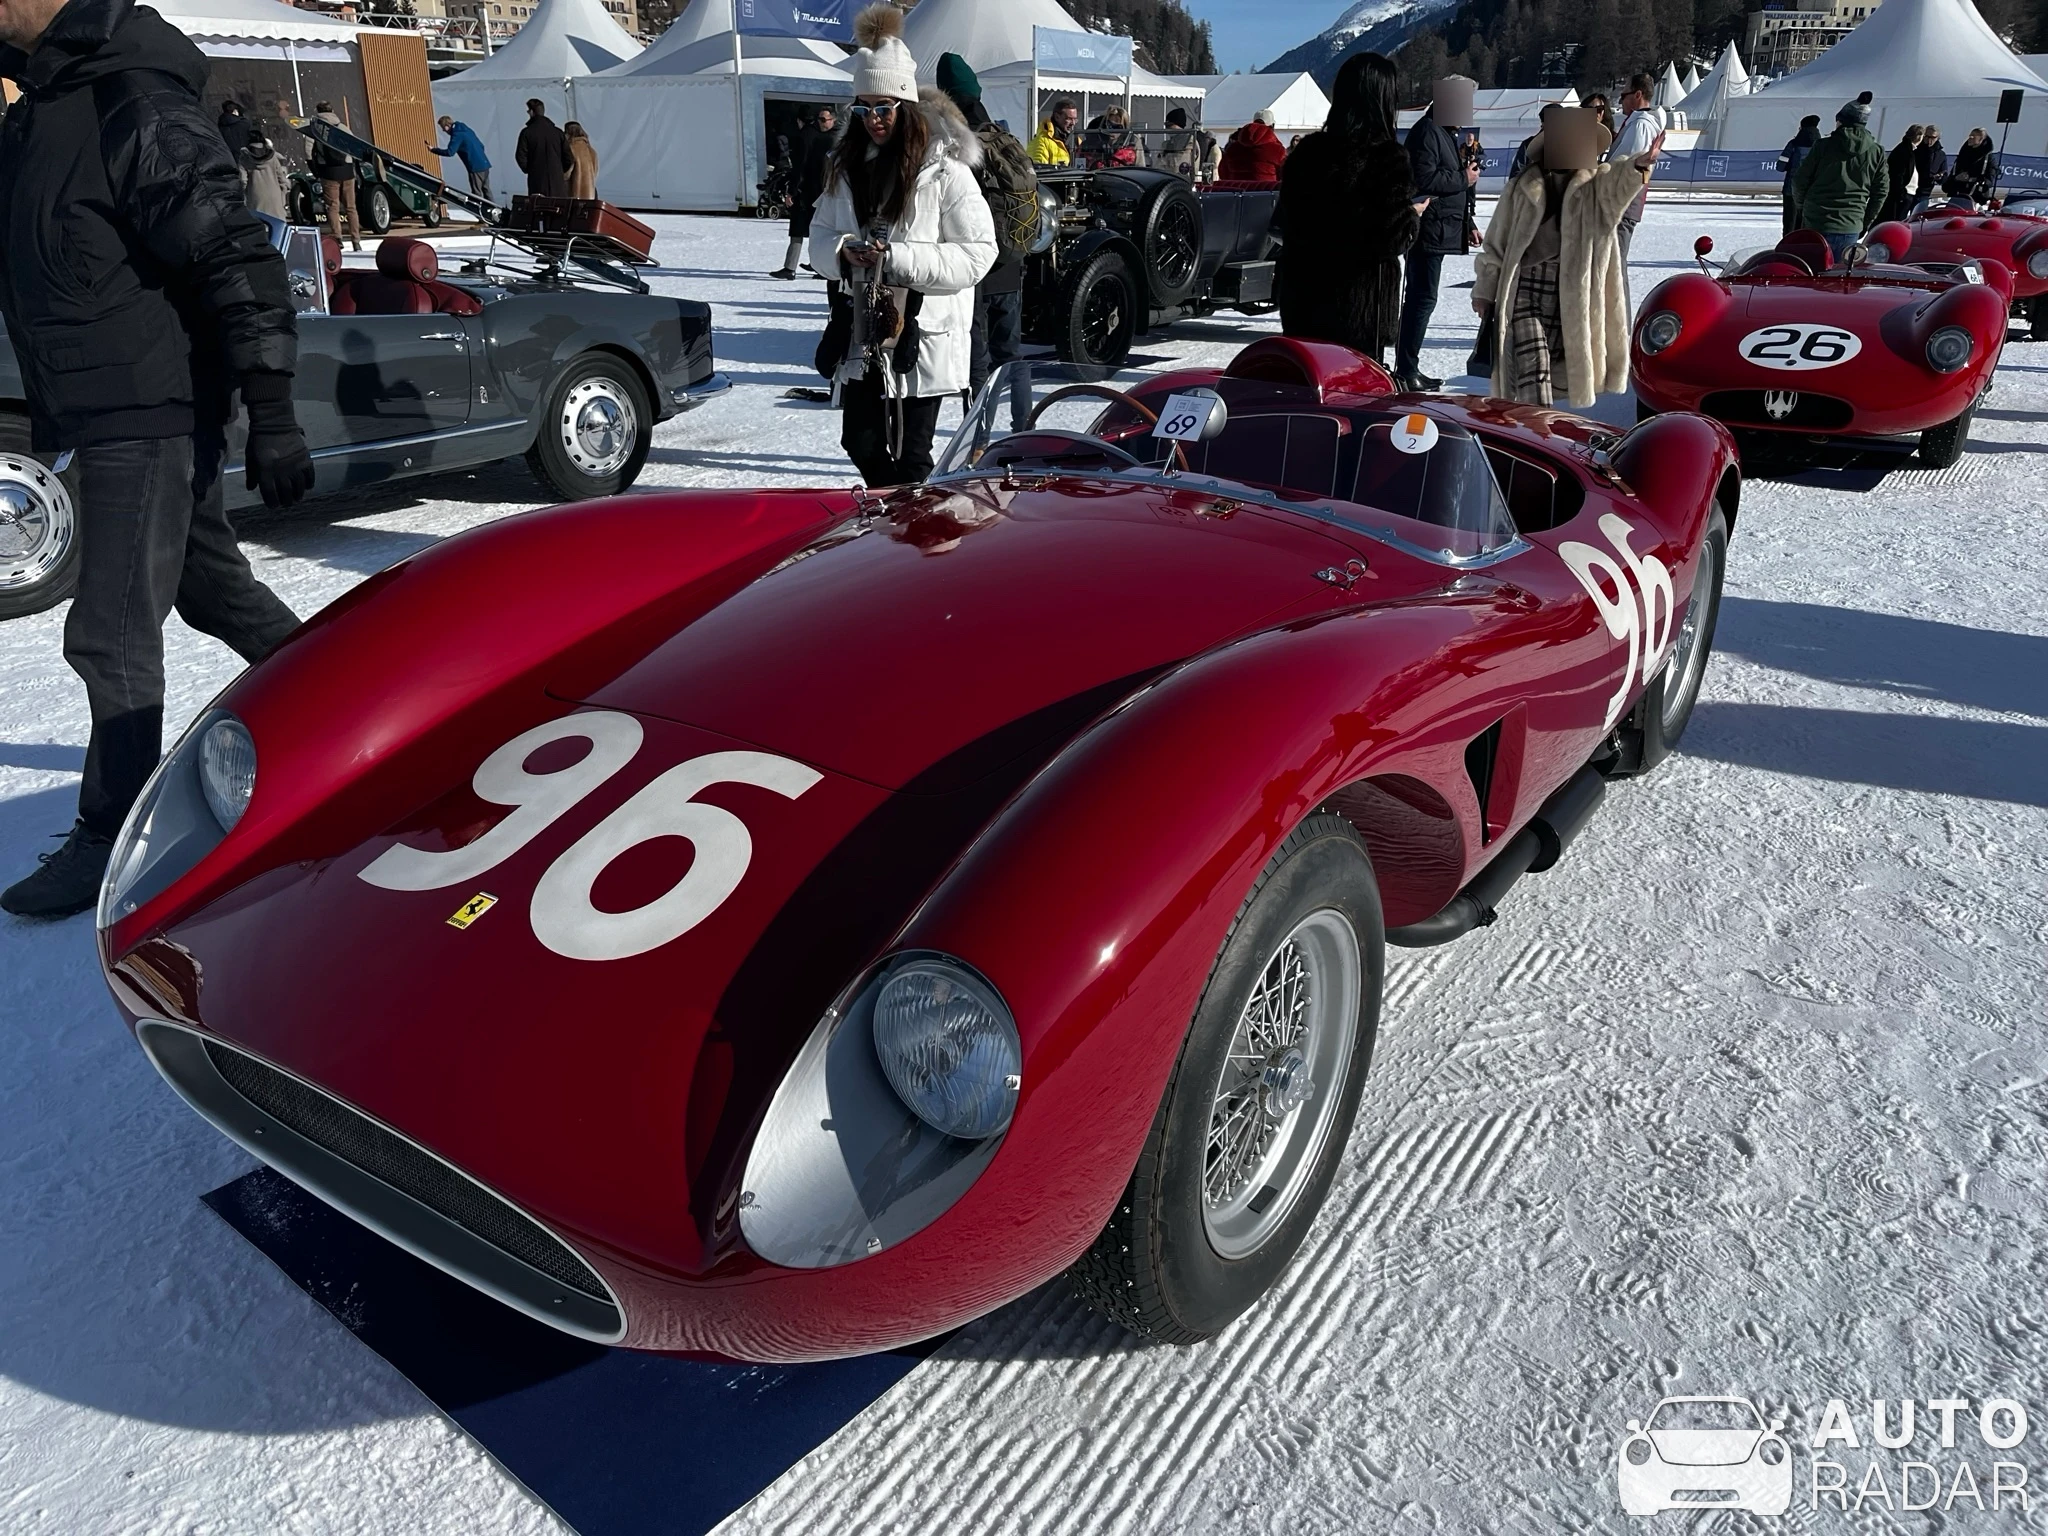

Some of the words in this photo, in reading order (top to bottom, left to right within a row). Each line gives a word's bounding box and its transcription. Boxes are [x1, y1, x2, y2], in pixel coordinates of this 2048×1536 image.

[802, 12, 841, 25] Maserati
[1656, 161, 1671, 170] ITZ
[1748, 328, 1851, 362] 26
[1164, 414, 1197, 435] 69
[1407, 438, 1417, 449] 2
[1558, 513, 1674, 731] 96
[357, 711, 824, 961] 96
